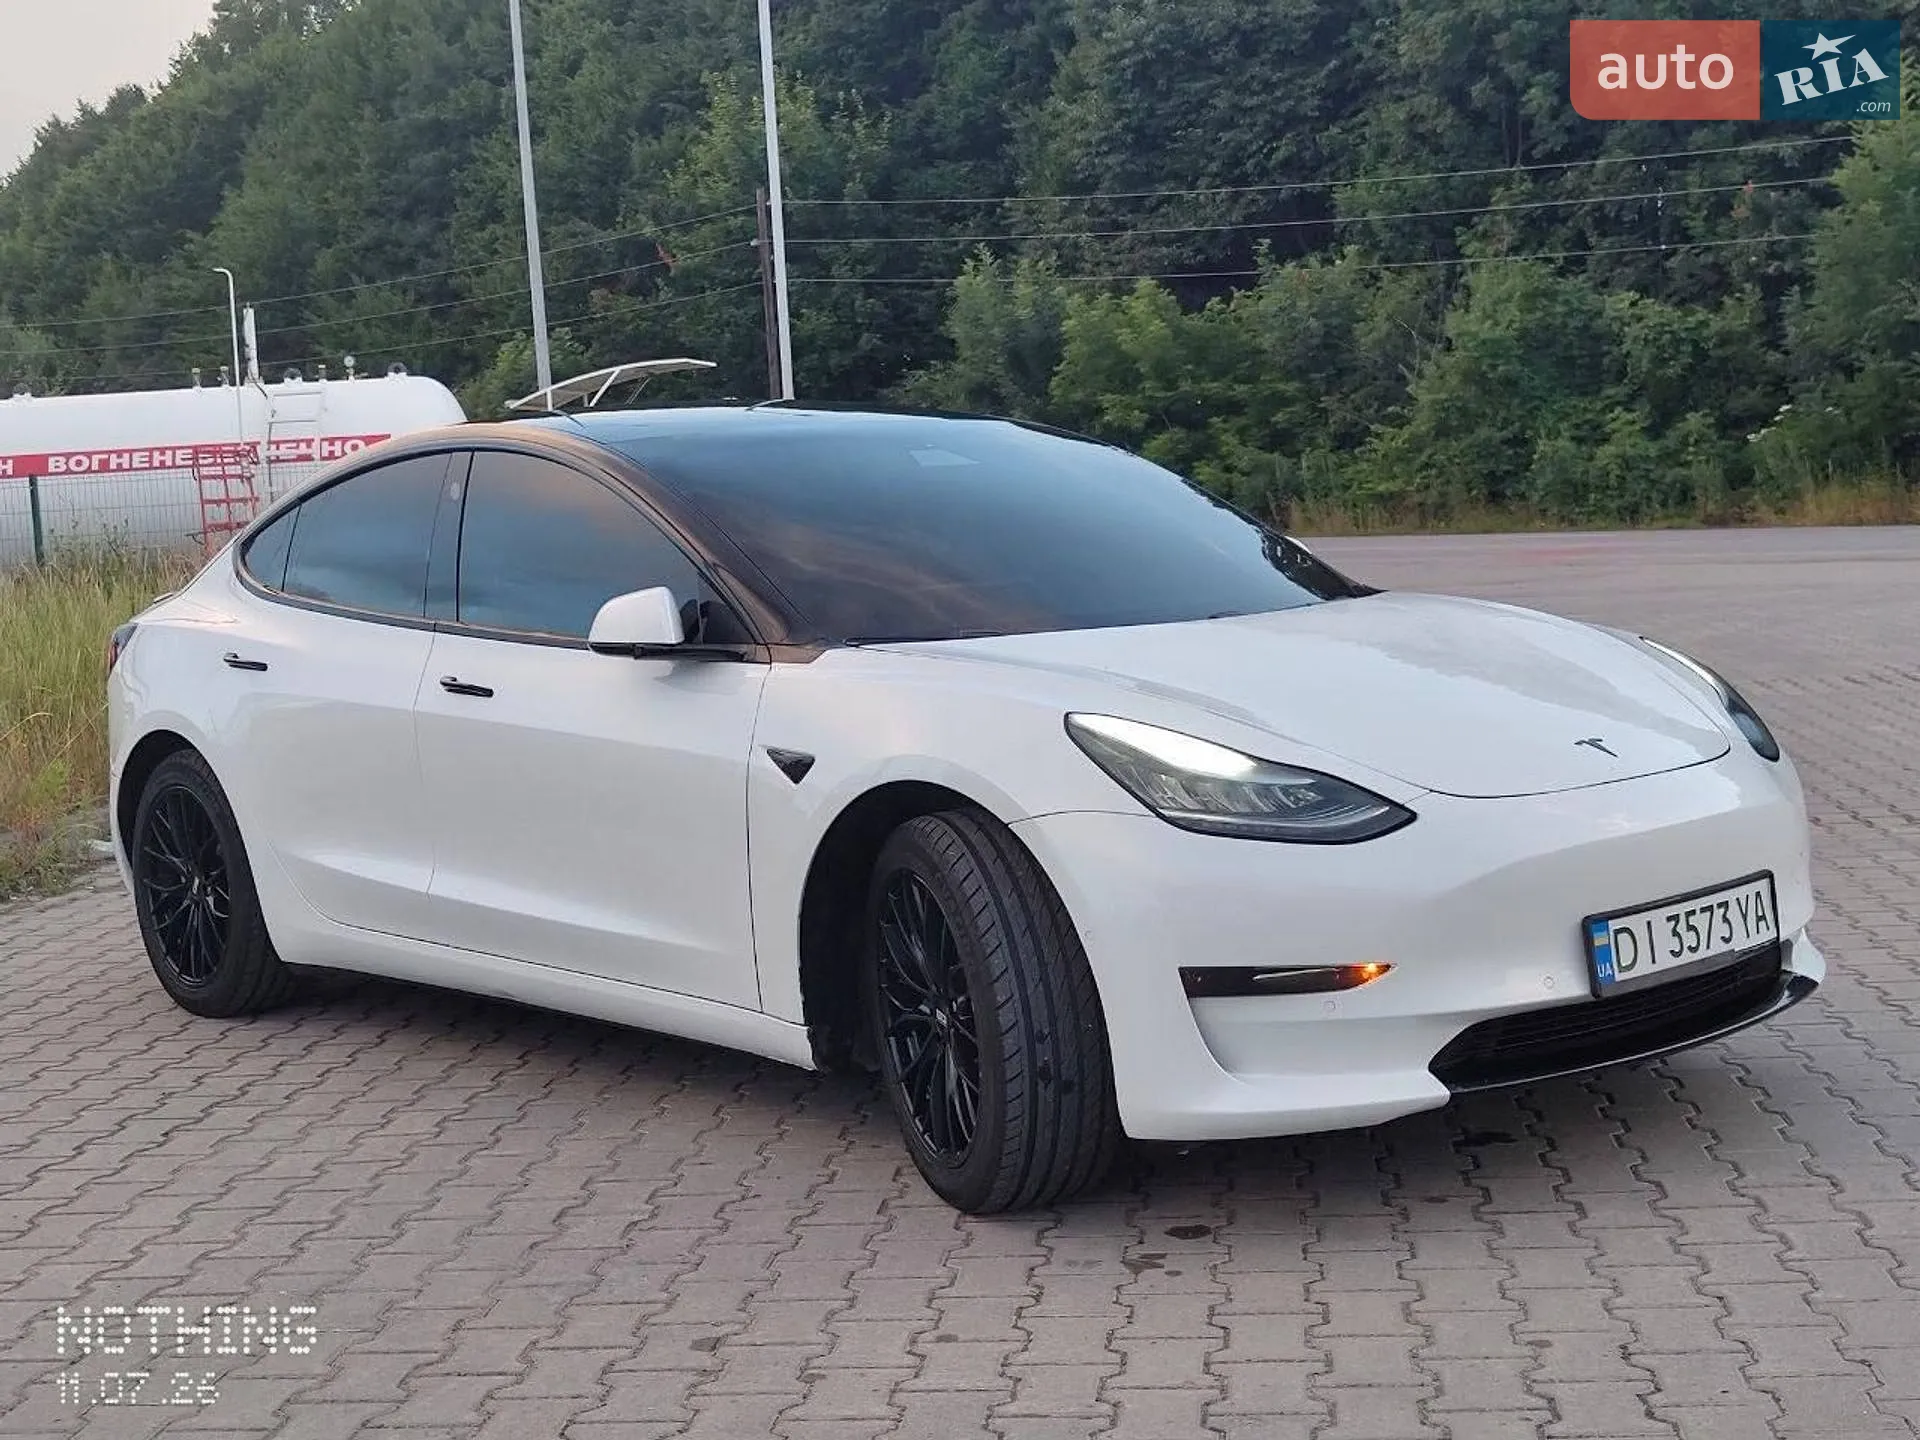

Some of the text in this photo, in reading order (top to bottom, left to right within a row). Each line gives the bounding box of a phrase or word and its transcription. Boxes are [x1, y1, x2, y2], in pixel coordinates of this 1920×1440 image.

[1613, 890, 1770, 973] DI 3573 YA
[1597, 963, 1613, 978] UA
